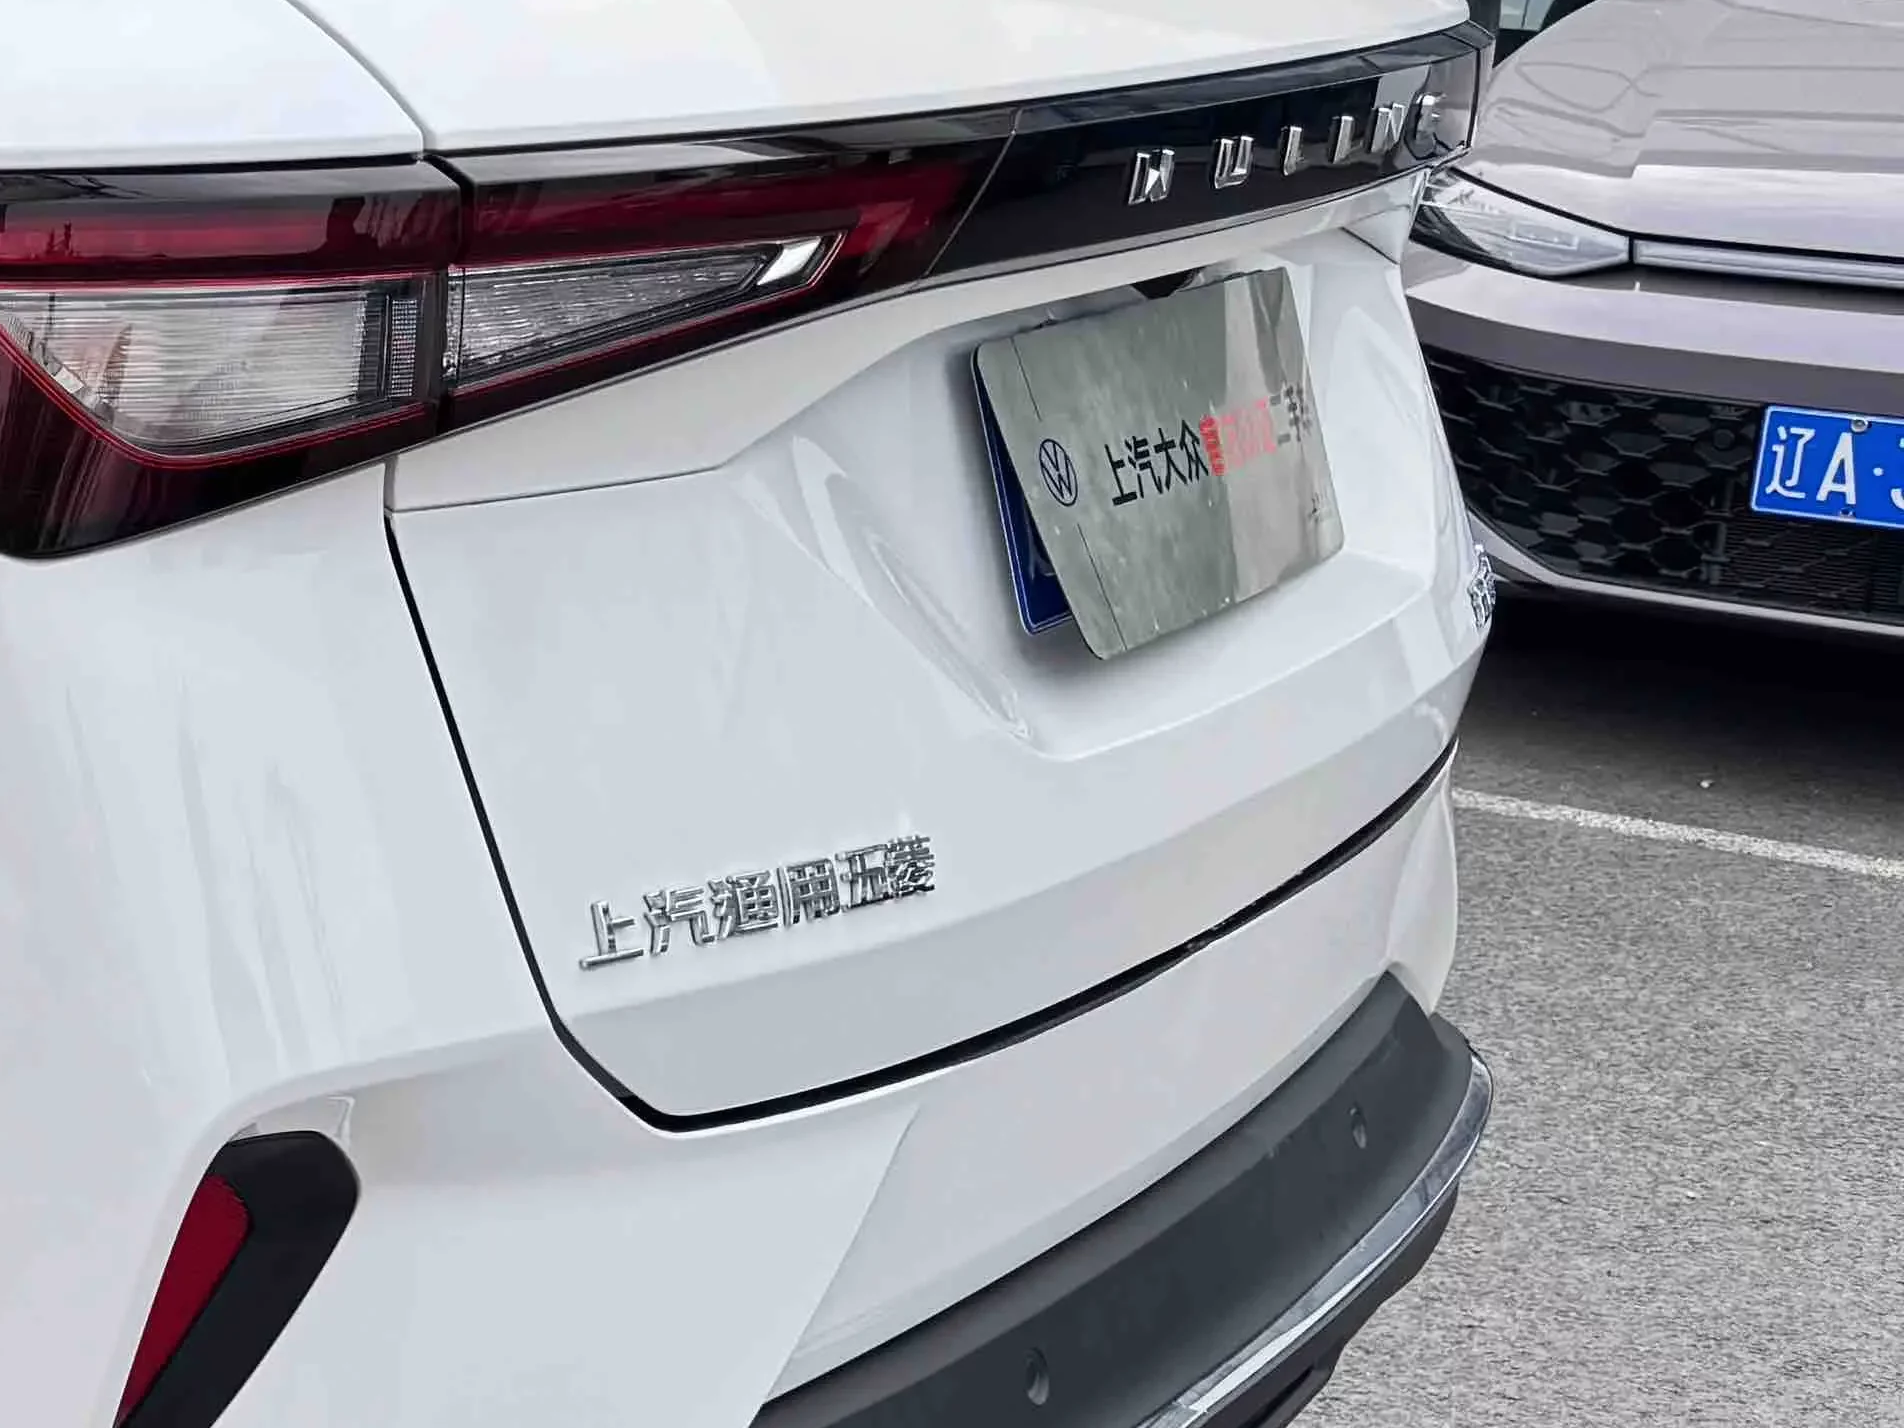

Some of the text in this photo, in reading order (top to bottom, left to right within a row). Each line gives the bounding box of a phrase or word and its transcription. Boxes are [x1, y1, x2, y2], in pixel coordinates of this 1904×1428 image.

[578, 834, 937, 972] 上汽通用五菱
